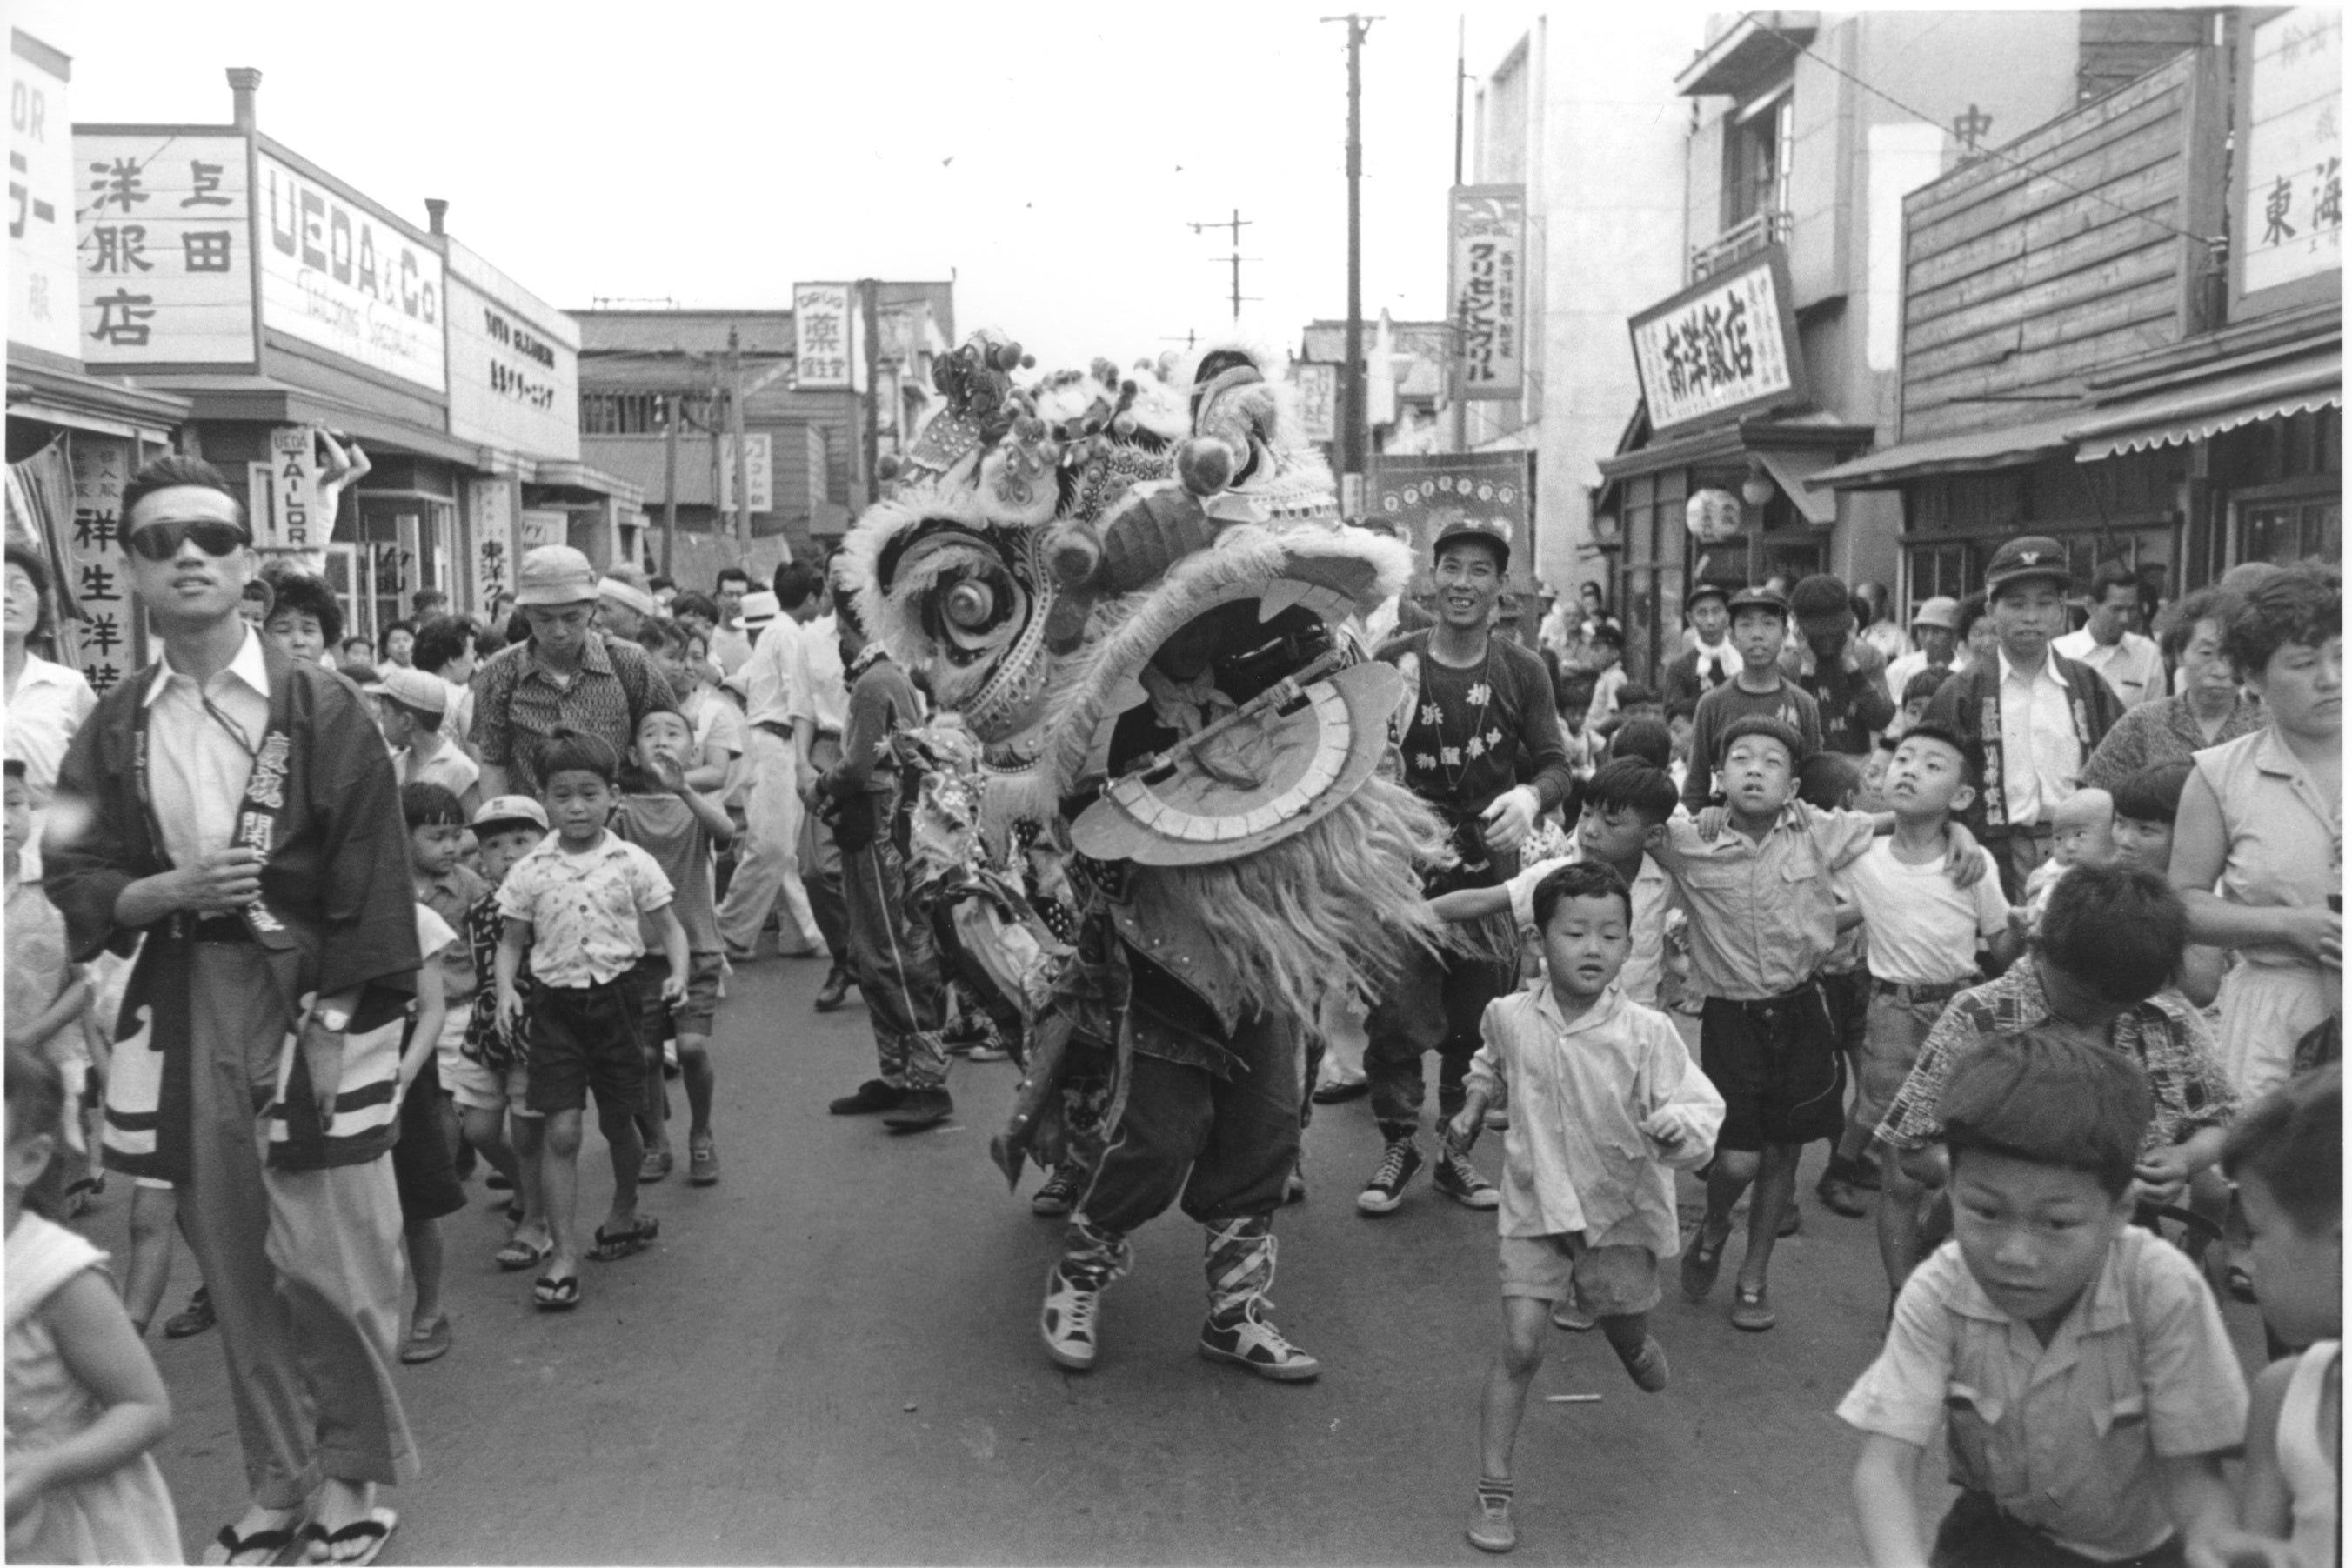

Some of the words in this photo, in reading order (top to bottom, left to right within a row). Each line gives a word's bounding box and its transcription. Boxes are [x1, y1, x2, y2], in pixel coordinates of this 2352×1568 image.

[1954, 103, 1992, 161] 中
[89, 157, 156, 346] 洋服店
[180, 160, 233, 273] 上田
[270, 170, 378, 300] UEDA
[281, 450, 307, 544] TAILOR
